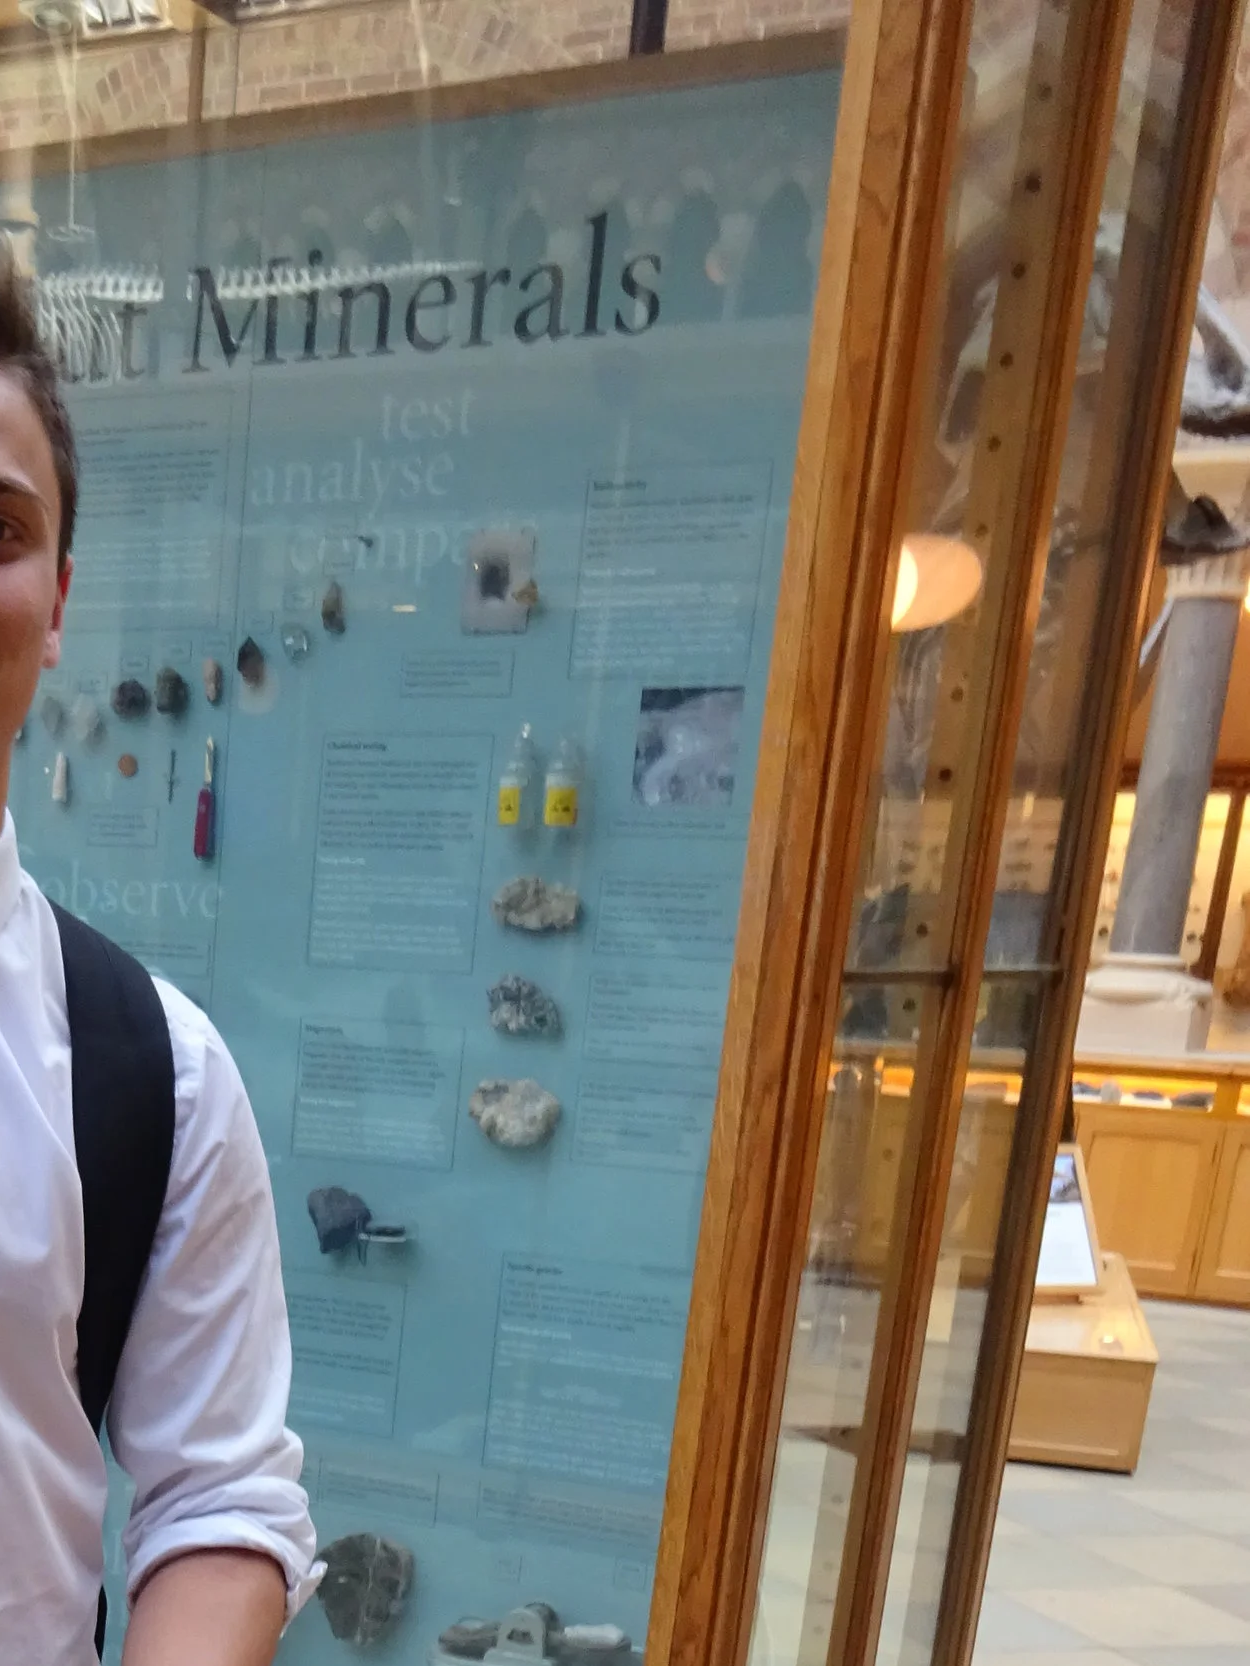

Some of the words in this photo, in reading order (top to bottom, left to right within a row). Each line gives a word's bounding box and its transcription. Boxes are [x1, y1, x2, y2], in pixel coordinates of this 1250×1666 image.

[181, 211, 662, 373] Minerals
[382, 387, 478, 441] test
[250, 436, 454, 520] analyse
